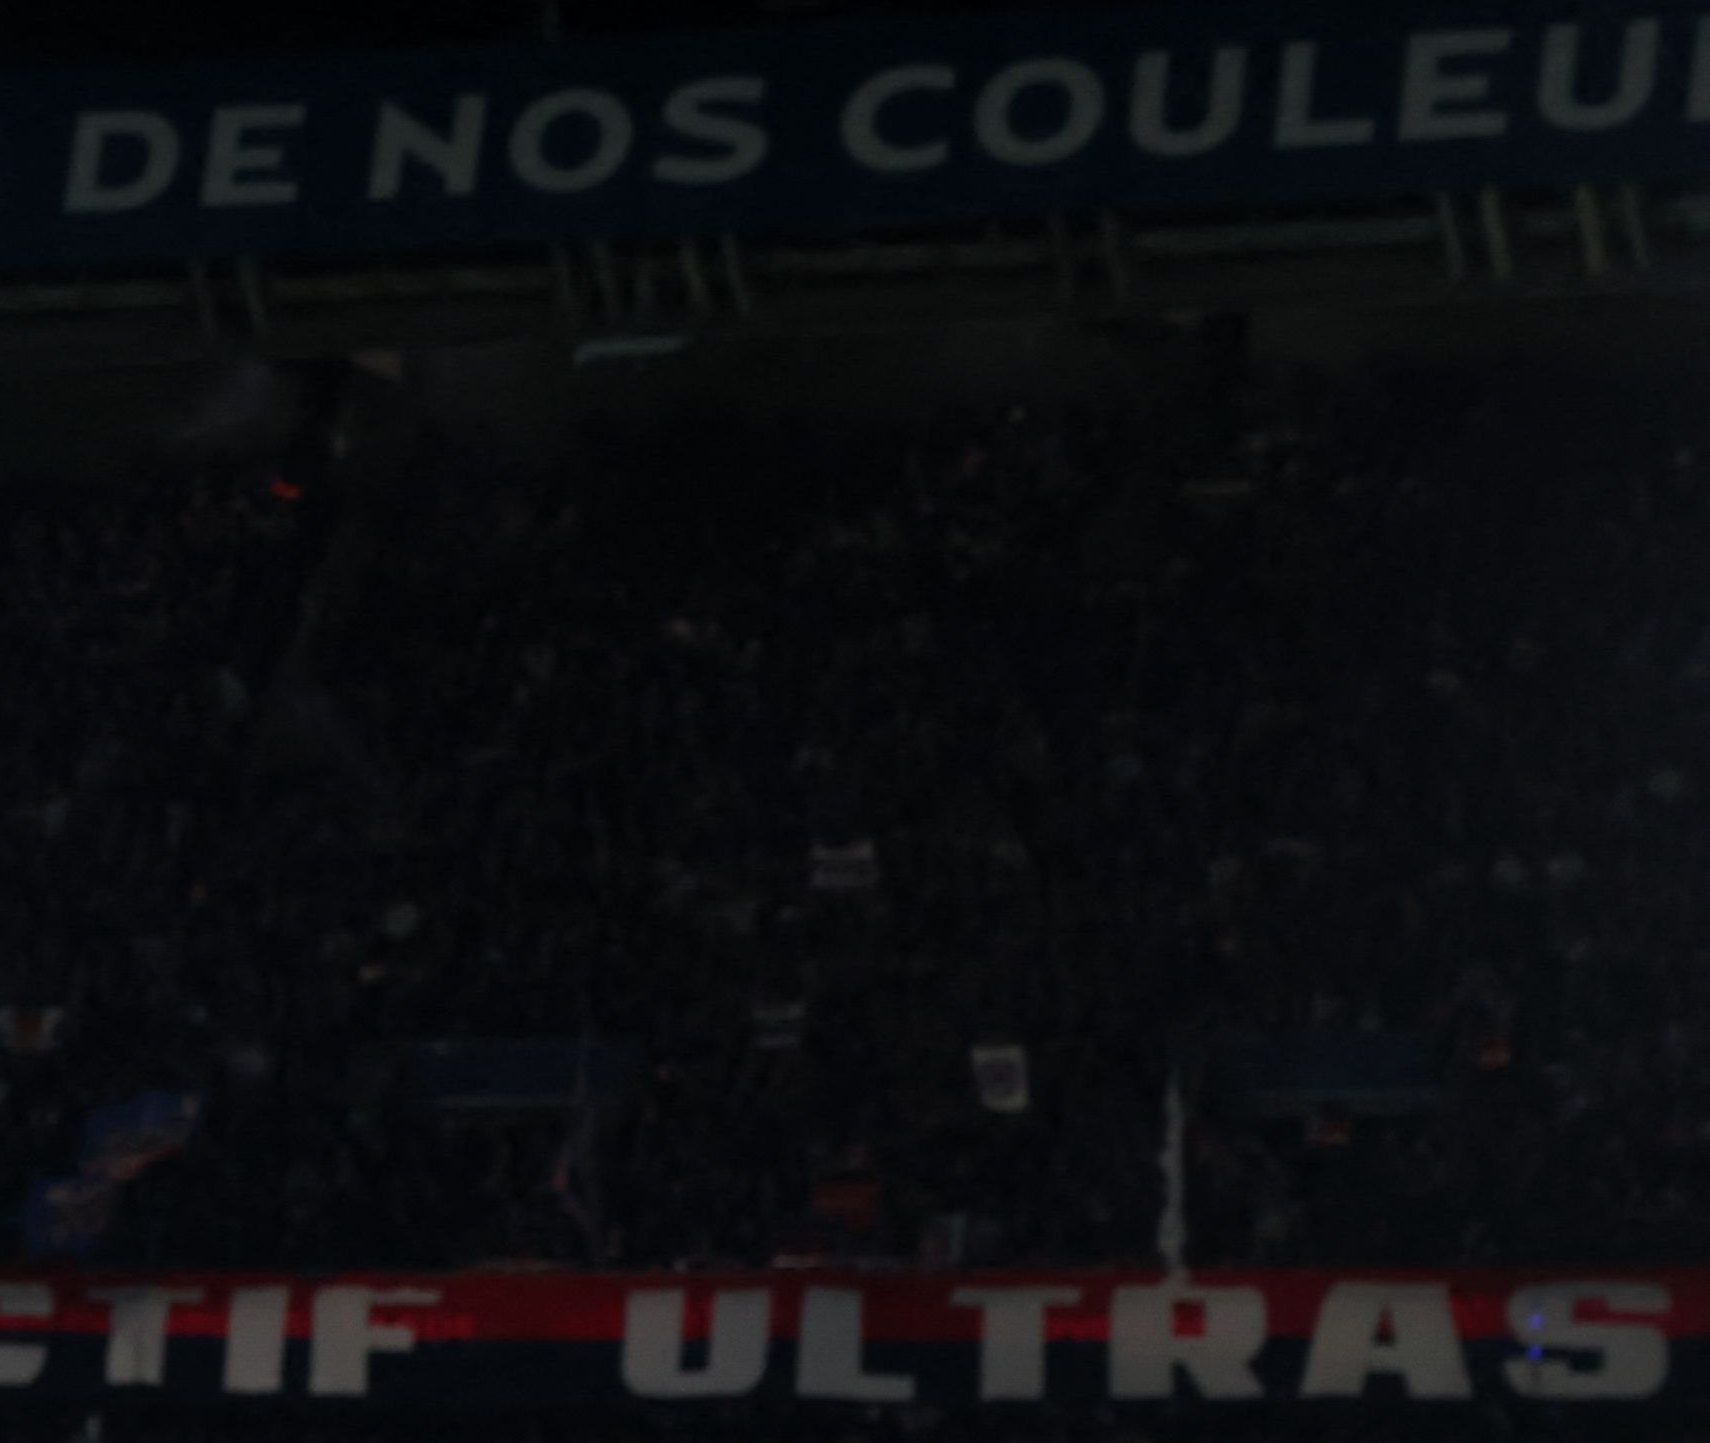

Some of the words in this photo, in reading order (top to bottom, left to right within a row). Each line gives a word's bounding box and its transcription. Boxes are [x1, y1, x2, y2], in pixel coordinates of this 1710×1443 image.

[61, 101, 309, 214] DE
[365, 76, 773, 203] NOS
[837, 14, 1710, 174] COULEU
[620, 1279, 1673, 1400] ULTRAS
